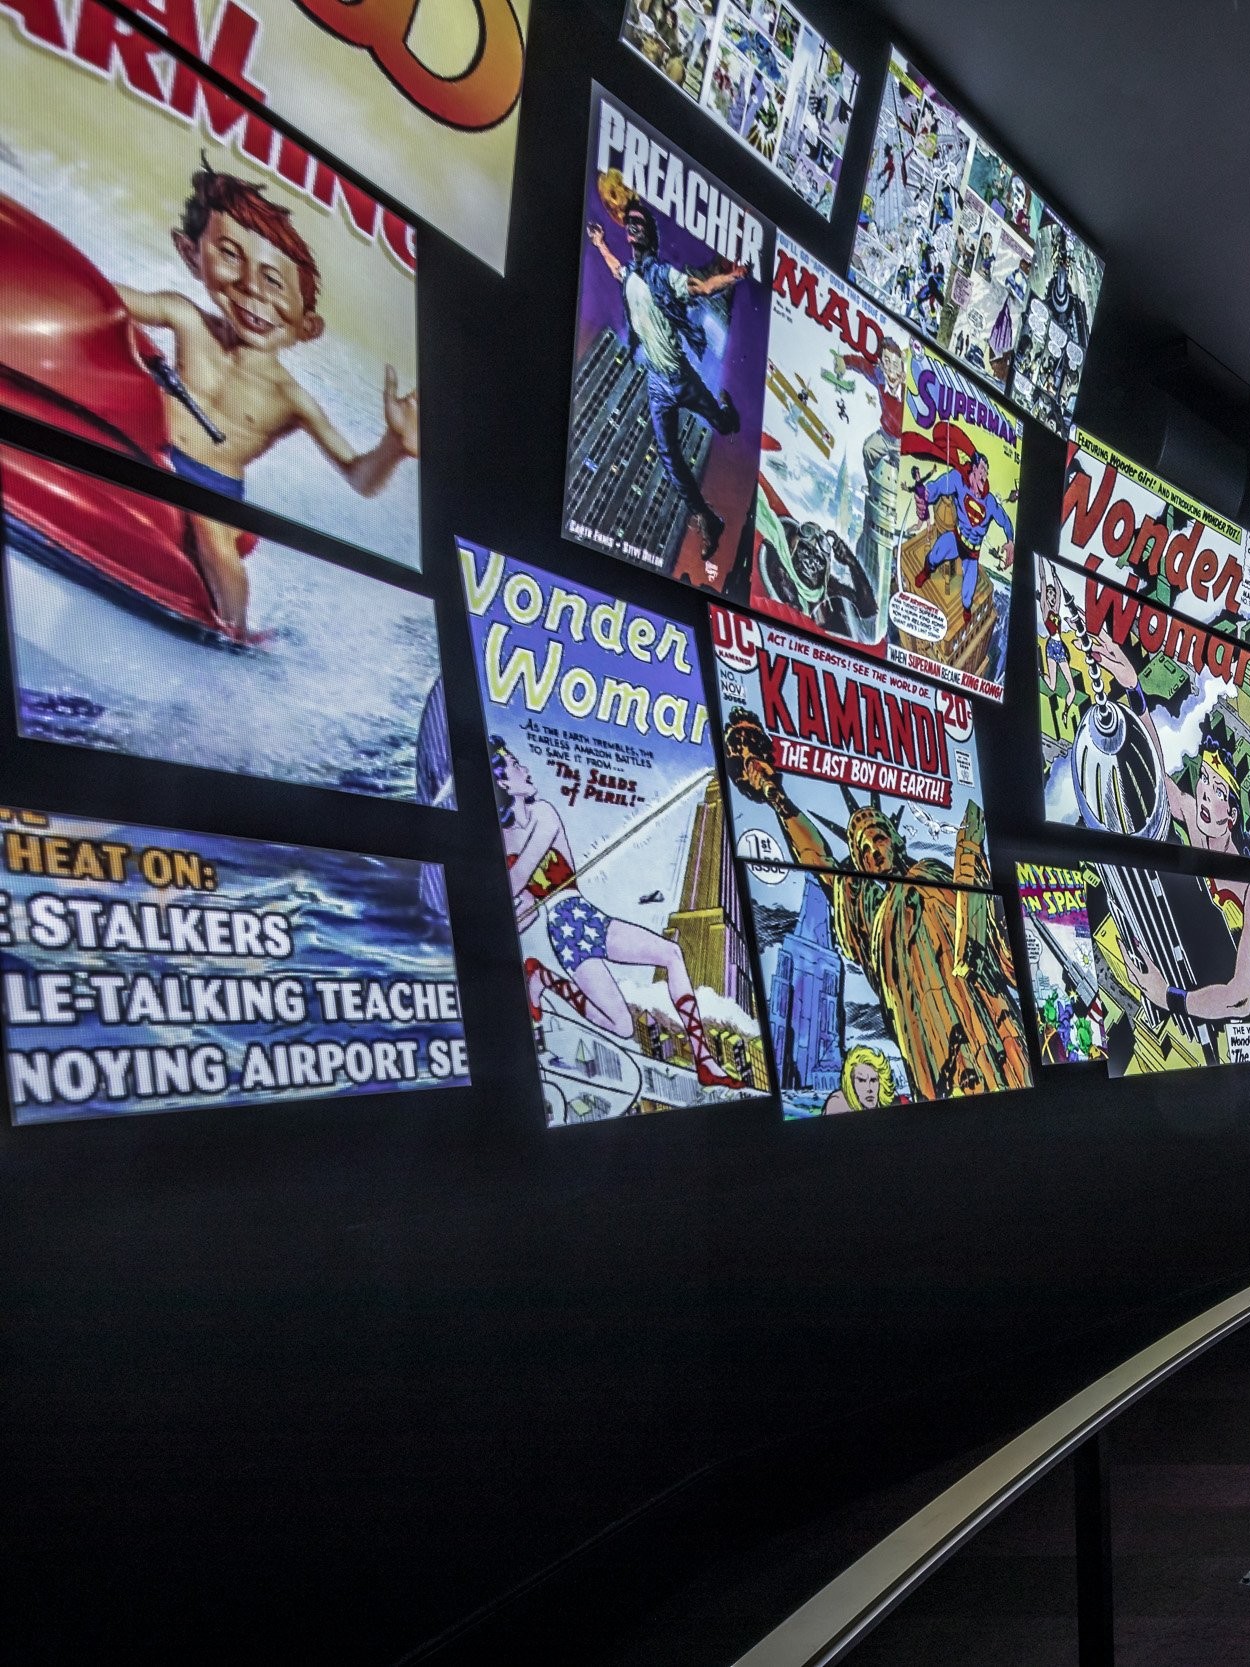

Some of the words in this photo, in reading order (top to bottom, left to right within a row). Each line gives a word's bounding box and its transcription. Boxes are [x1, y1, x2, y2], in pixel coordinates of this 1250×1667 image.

[598, 100, 764, 283] PREACHER
[772, 248, 885, 364] MAD
[917, 369, 1018, 450] SUPERMAN
[1077, 433, 1109, 463] FEATURING
[1158, 483, 1170, 499] AND
[1170, 491, 1202, 518] INTRODUCING
[1202, 511, 1227, 531] WONDER
[1061, 440, 1244, 614] Wonder
[711, 603, 756, 658] DC
[767, 632, 787, 647] ACT
[789, 641, 810, 656] LIKE
[812, 648, 851, 672] BEASTS!
[853, 662, 870, 677] SEE
[872, 669, 887, 684] THE
[890, 676, 917, 694] WORLD
[908, 654, 941, 678] SUPERMAN
[941, 665, 961, 684] BECAME
[961, 674, 980, 691] KING
[563, 730, 590, 744] EARTH
[756, 646, 951, 779] KAMANDI
[527, 732, 570, 750] FEARLESS
[574, 743, 612, 760] AMAZON
[615, 751, 652, 769] BATTLES
[529, 743, 542, 756] TO
[546, 748, 571, 762] SAVE
[574, 754, 582, 763] IT
[780, 741, 808, 770] THE
[812, 749, 848, 778] LAST
[852, 759, 876, 785] BOY
[879, 769, 897, 792] ON
[900, 774, 945, 802] EARTH!
[7, 832, 127, 882] HEAT
[142, 848, 216, 891] ON:
[30, 894, 291, 958] STALKERS
[1022, 895, 1042, 912] IN
[5, 972, 304, 1025] LE-TALKING
[317, 980, 462, 1025] TEACHE
[1232, 1026, 1245, 1035] THE
[13, 1046, 228, 1105] NOYING
[243, 1040, 418, 1091] AIRPORT
